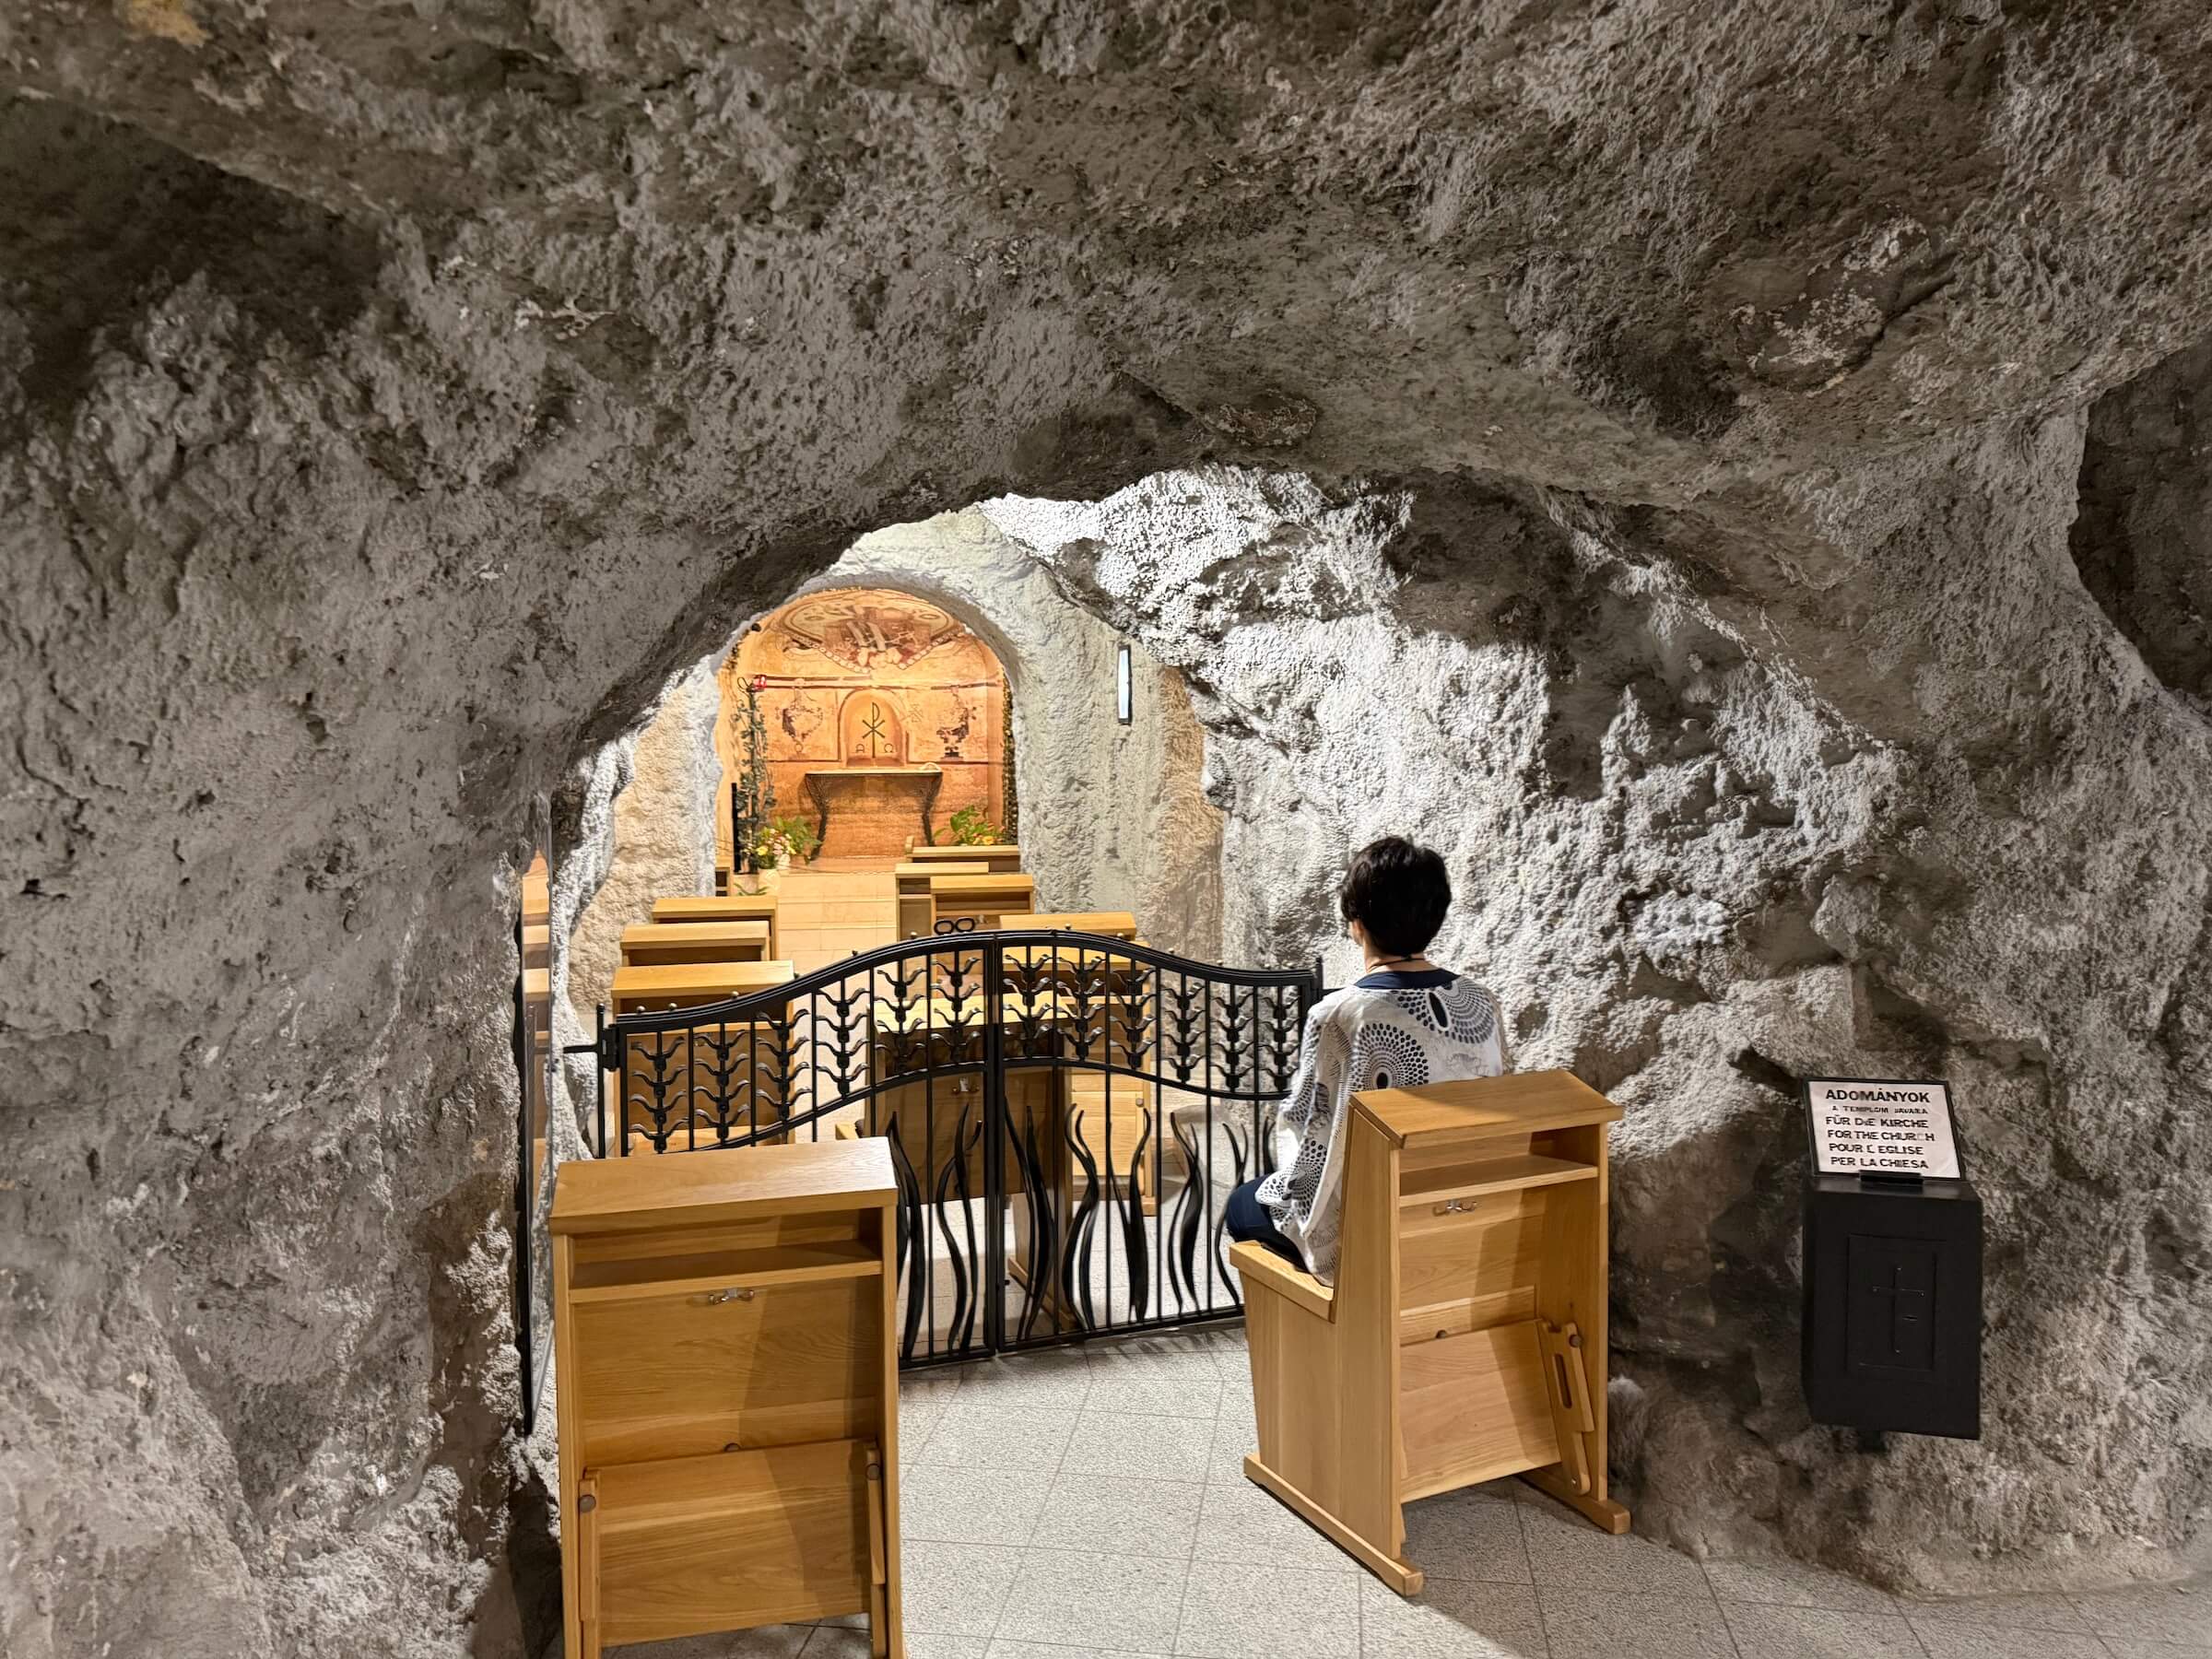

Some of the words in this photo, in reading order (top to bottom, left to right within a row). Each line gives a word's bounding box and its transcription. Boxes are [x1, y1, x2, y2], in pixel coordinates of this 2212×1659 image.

[1826, 1088, 1930, 1103] ADOMÁNYOK
[1825, 1114, 1851, 1125] FÜR
[1854, 1117, 1876, 1126] DIE
[1880, 1118, 1929, 1128] KIRCHE
[1828, 1130, 1852, 1139] FOR
[1853, 1130, 1878, 1139] THE
[1829, 1143, 1863, 1153] POUR
[1830, 1157, 1856, 1166] PER
[1860, 1158, 1877, 1167] LA
[1879, 1159, 1929, 1169] CHIESA
